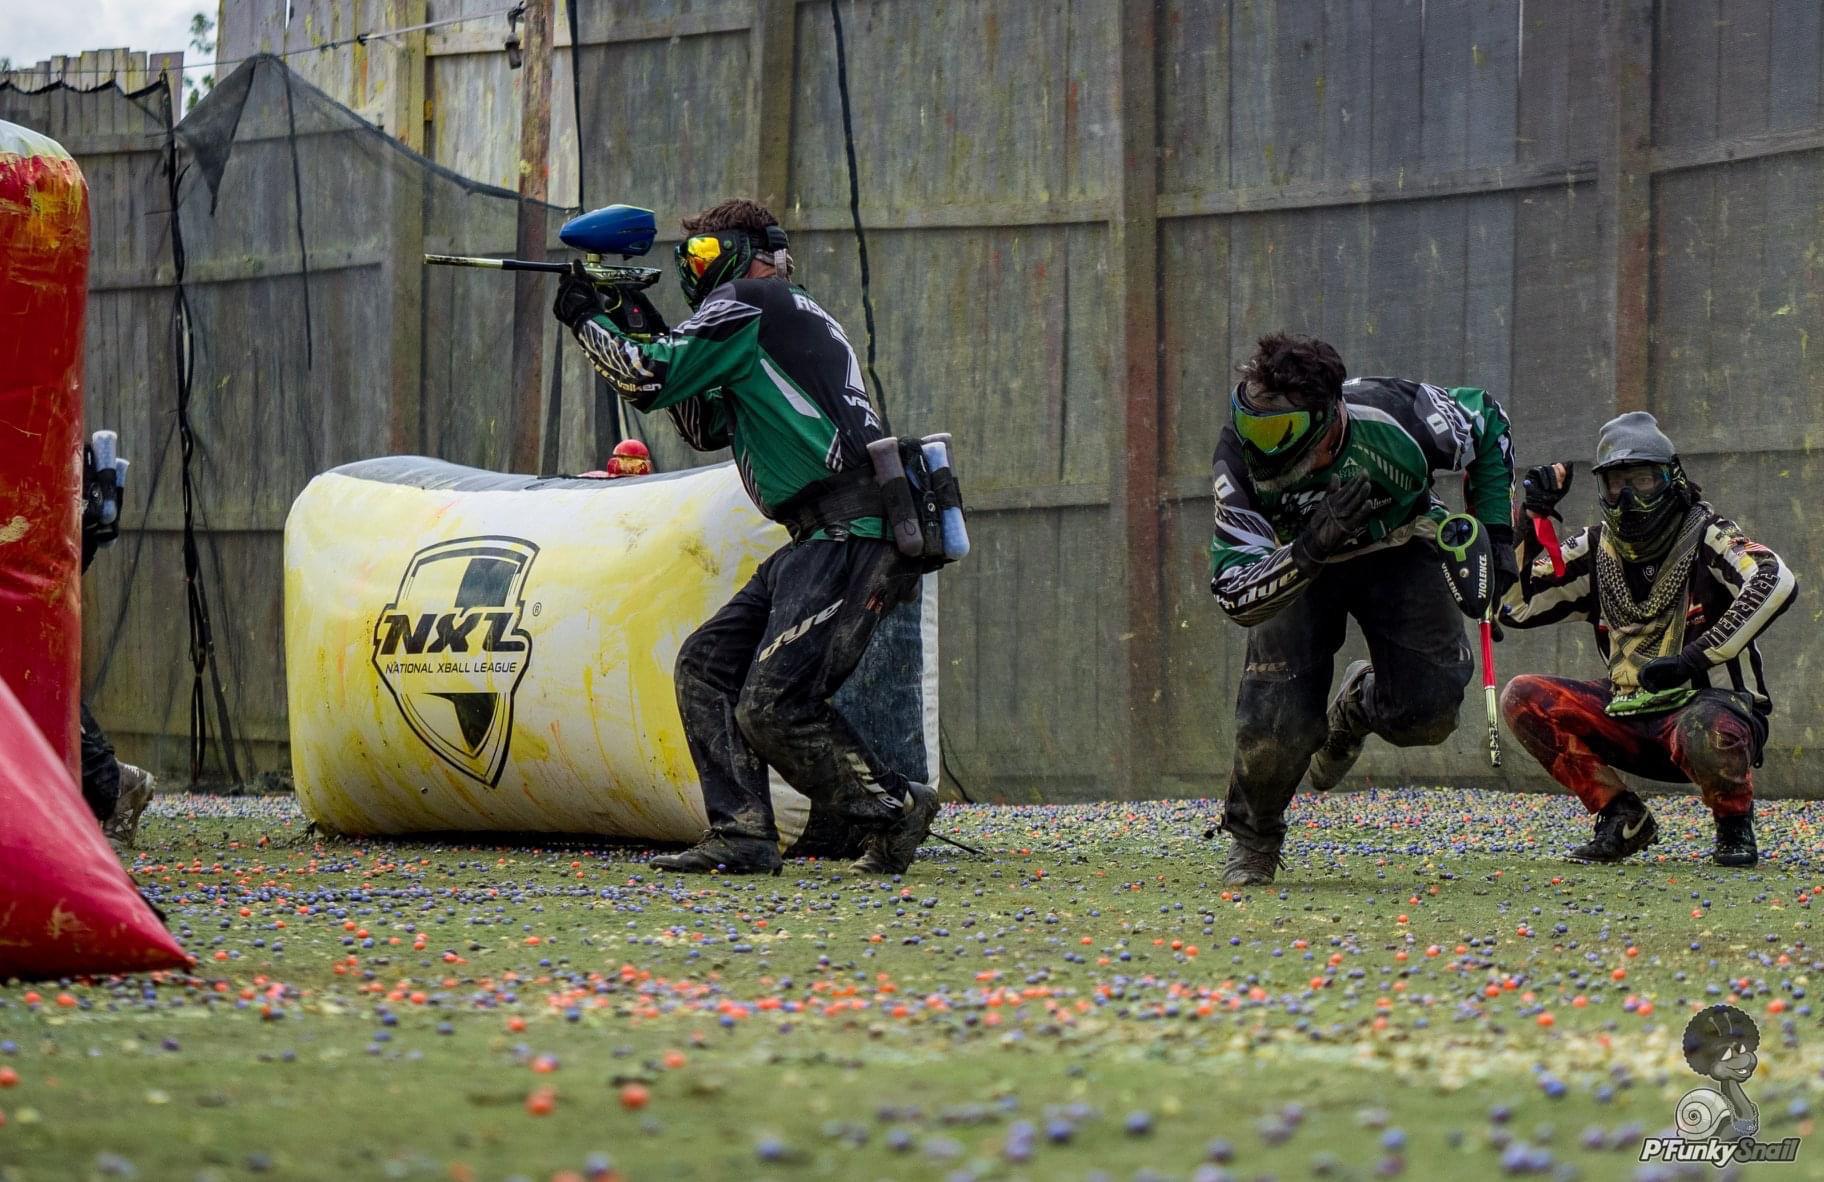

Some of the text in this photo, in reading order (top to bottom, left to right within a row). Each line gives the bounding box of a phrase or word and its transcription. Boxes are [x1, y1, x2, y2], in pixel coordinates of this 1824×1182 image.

[1441, 562, 1464, 602] VIOLENCE
[1477, 554, 1488, 599] VIOLENCE
[380, 612, 526, 655] NXL
[758, 599, 844, 662] dye
[385, 661, 518, 674] NATIONAL XBALL LEAGUE
